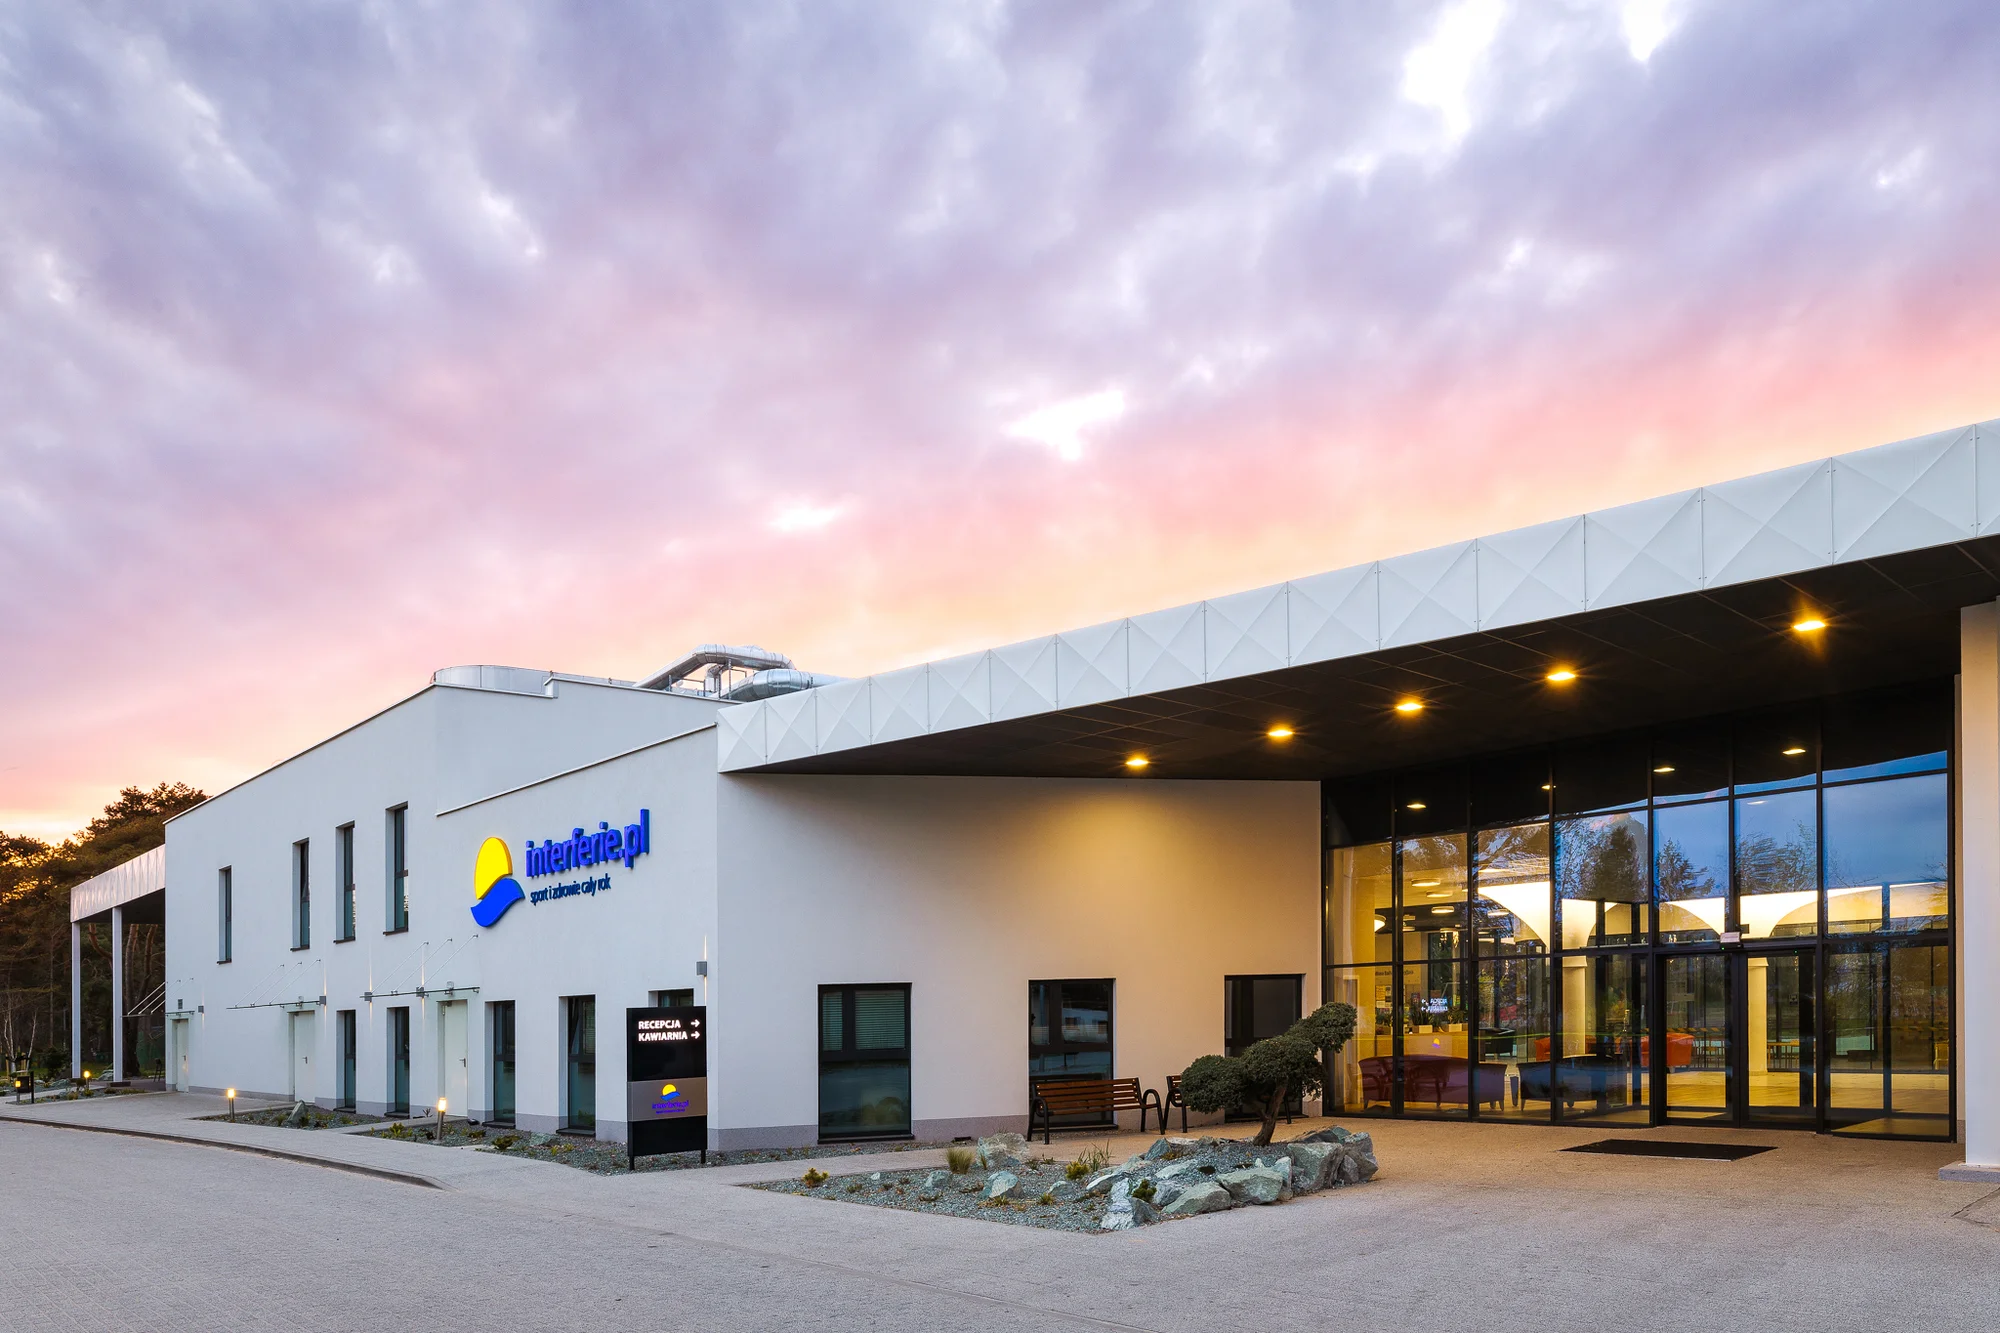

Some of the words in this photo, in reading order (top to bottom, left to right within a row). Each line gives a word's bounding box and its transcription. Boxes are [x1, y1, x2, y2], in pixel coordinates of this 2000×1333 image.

[526, 808, 650, 877] interferie.pl
[530, 887, 549, 906] sport
[552, 881, 581, 900] zdrowie
[597, 872, 612, 891] rok
[638, 1019, 681, 1030] RECEPCJA
[638, 1031, 688, 1042] KAWIARNIA
